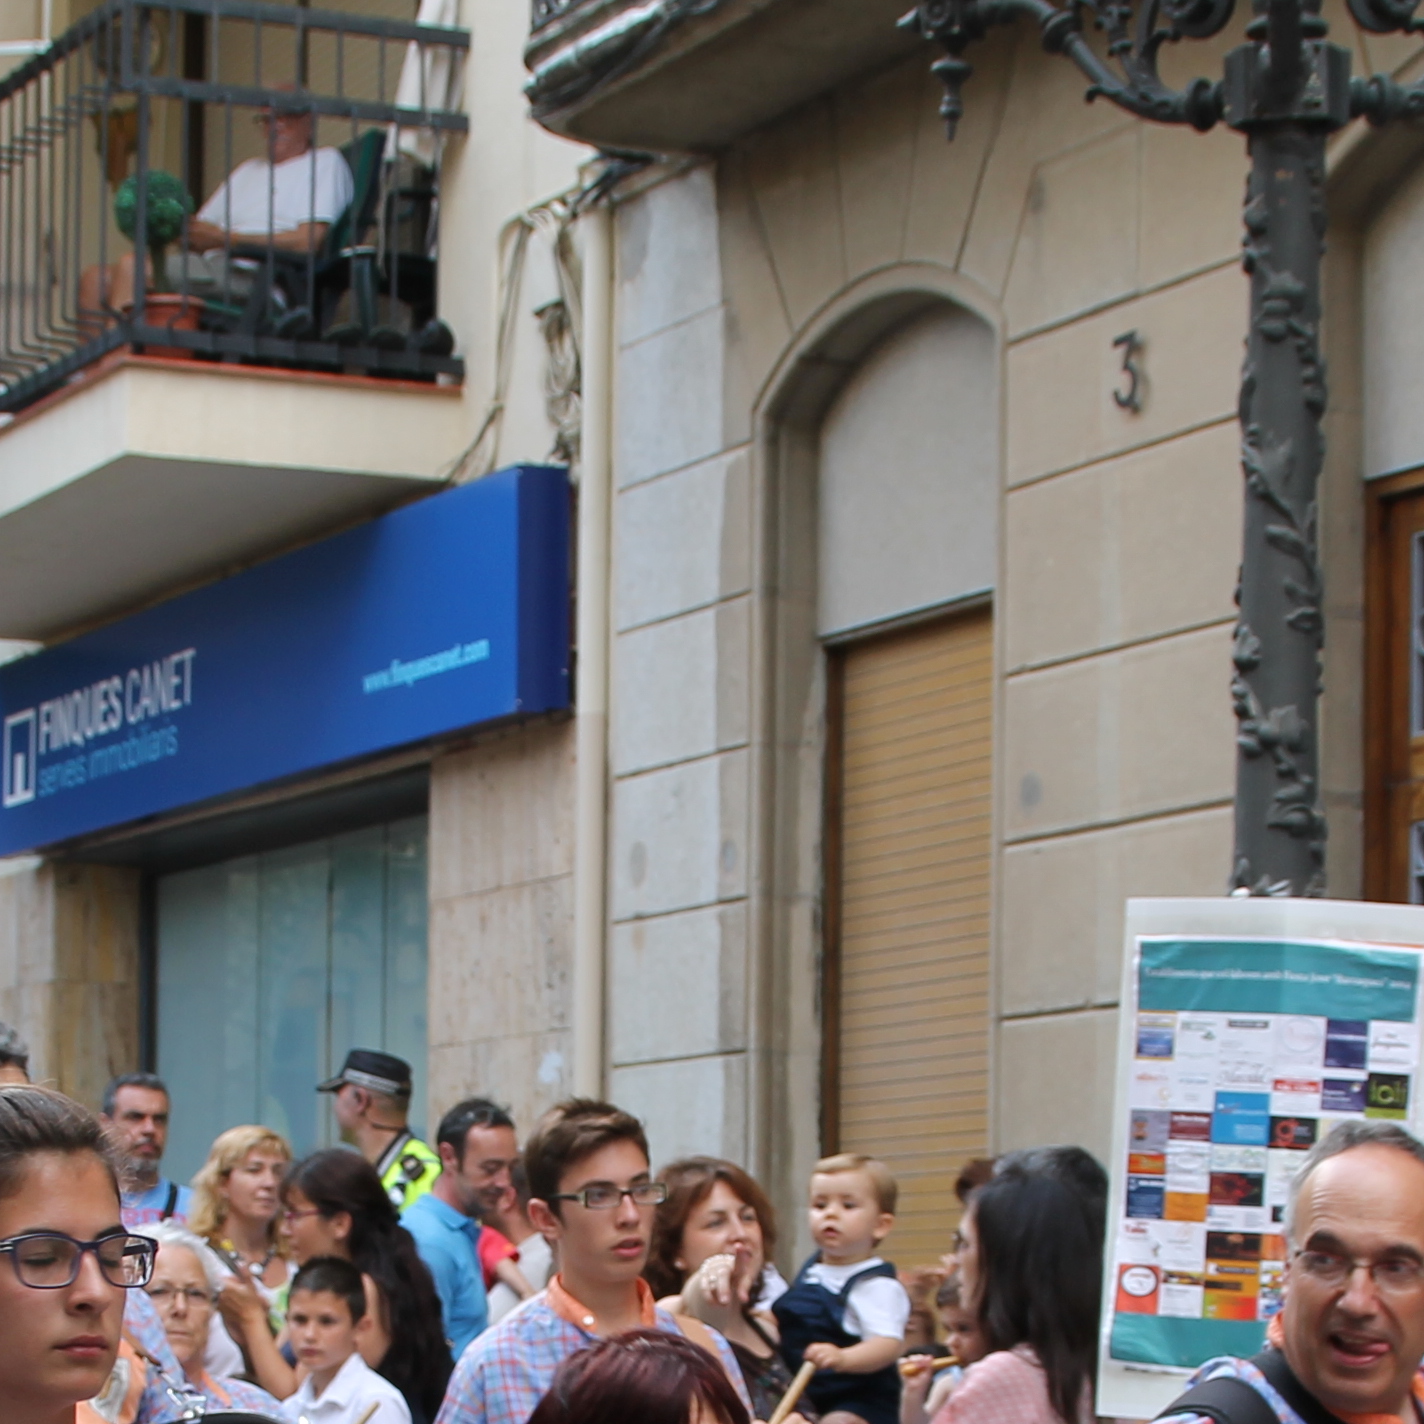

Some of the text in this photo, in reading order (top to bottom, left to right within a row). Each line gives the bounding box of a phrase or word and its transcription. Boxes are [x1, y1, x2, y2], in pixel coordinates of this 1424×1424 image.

[1112, 329, 1146, 414] 3
[38, 647, 197, 756] FINQUES CANET
